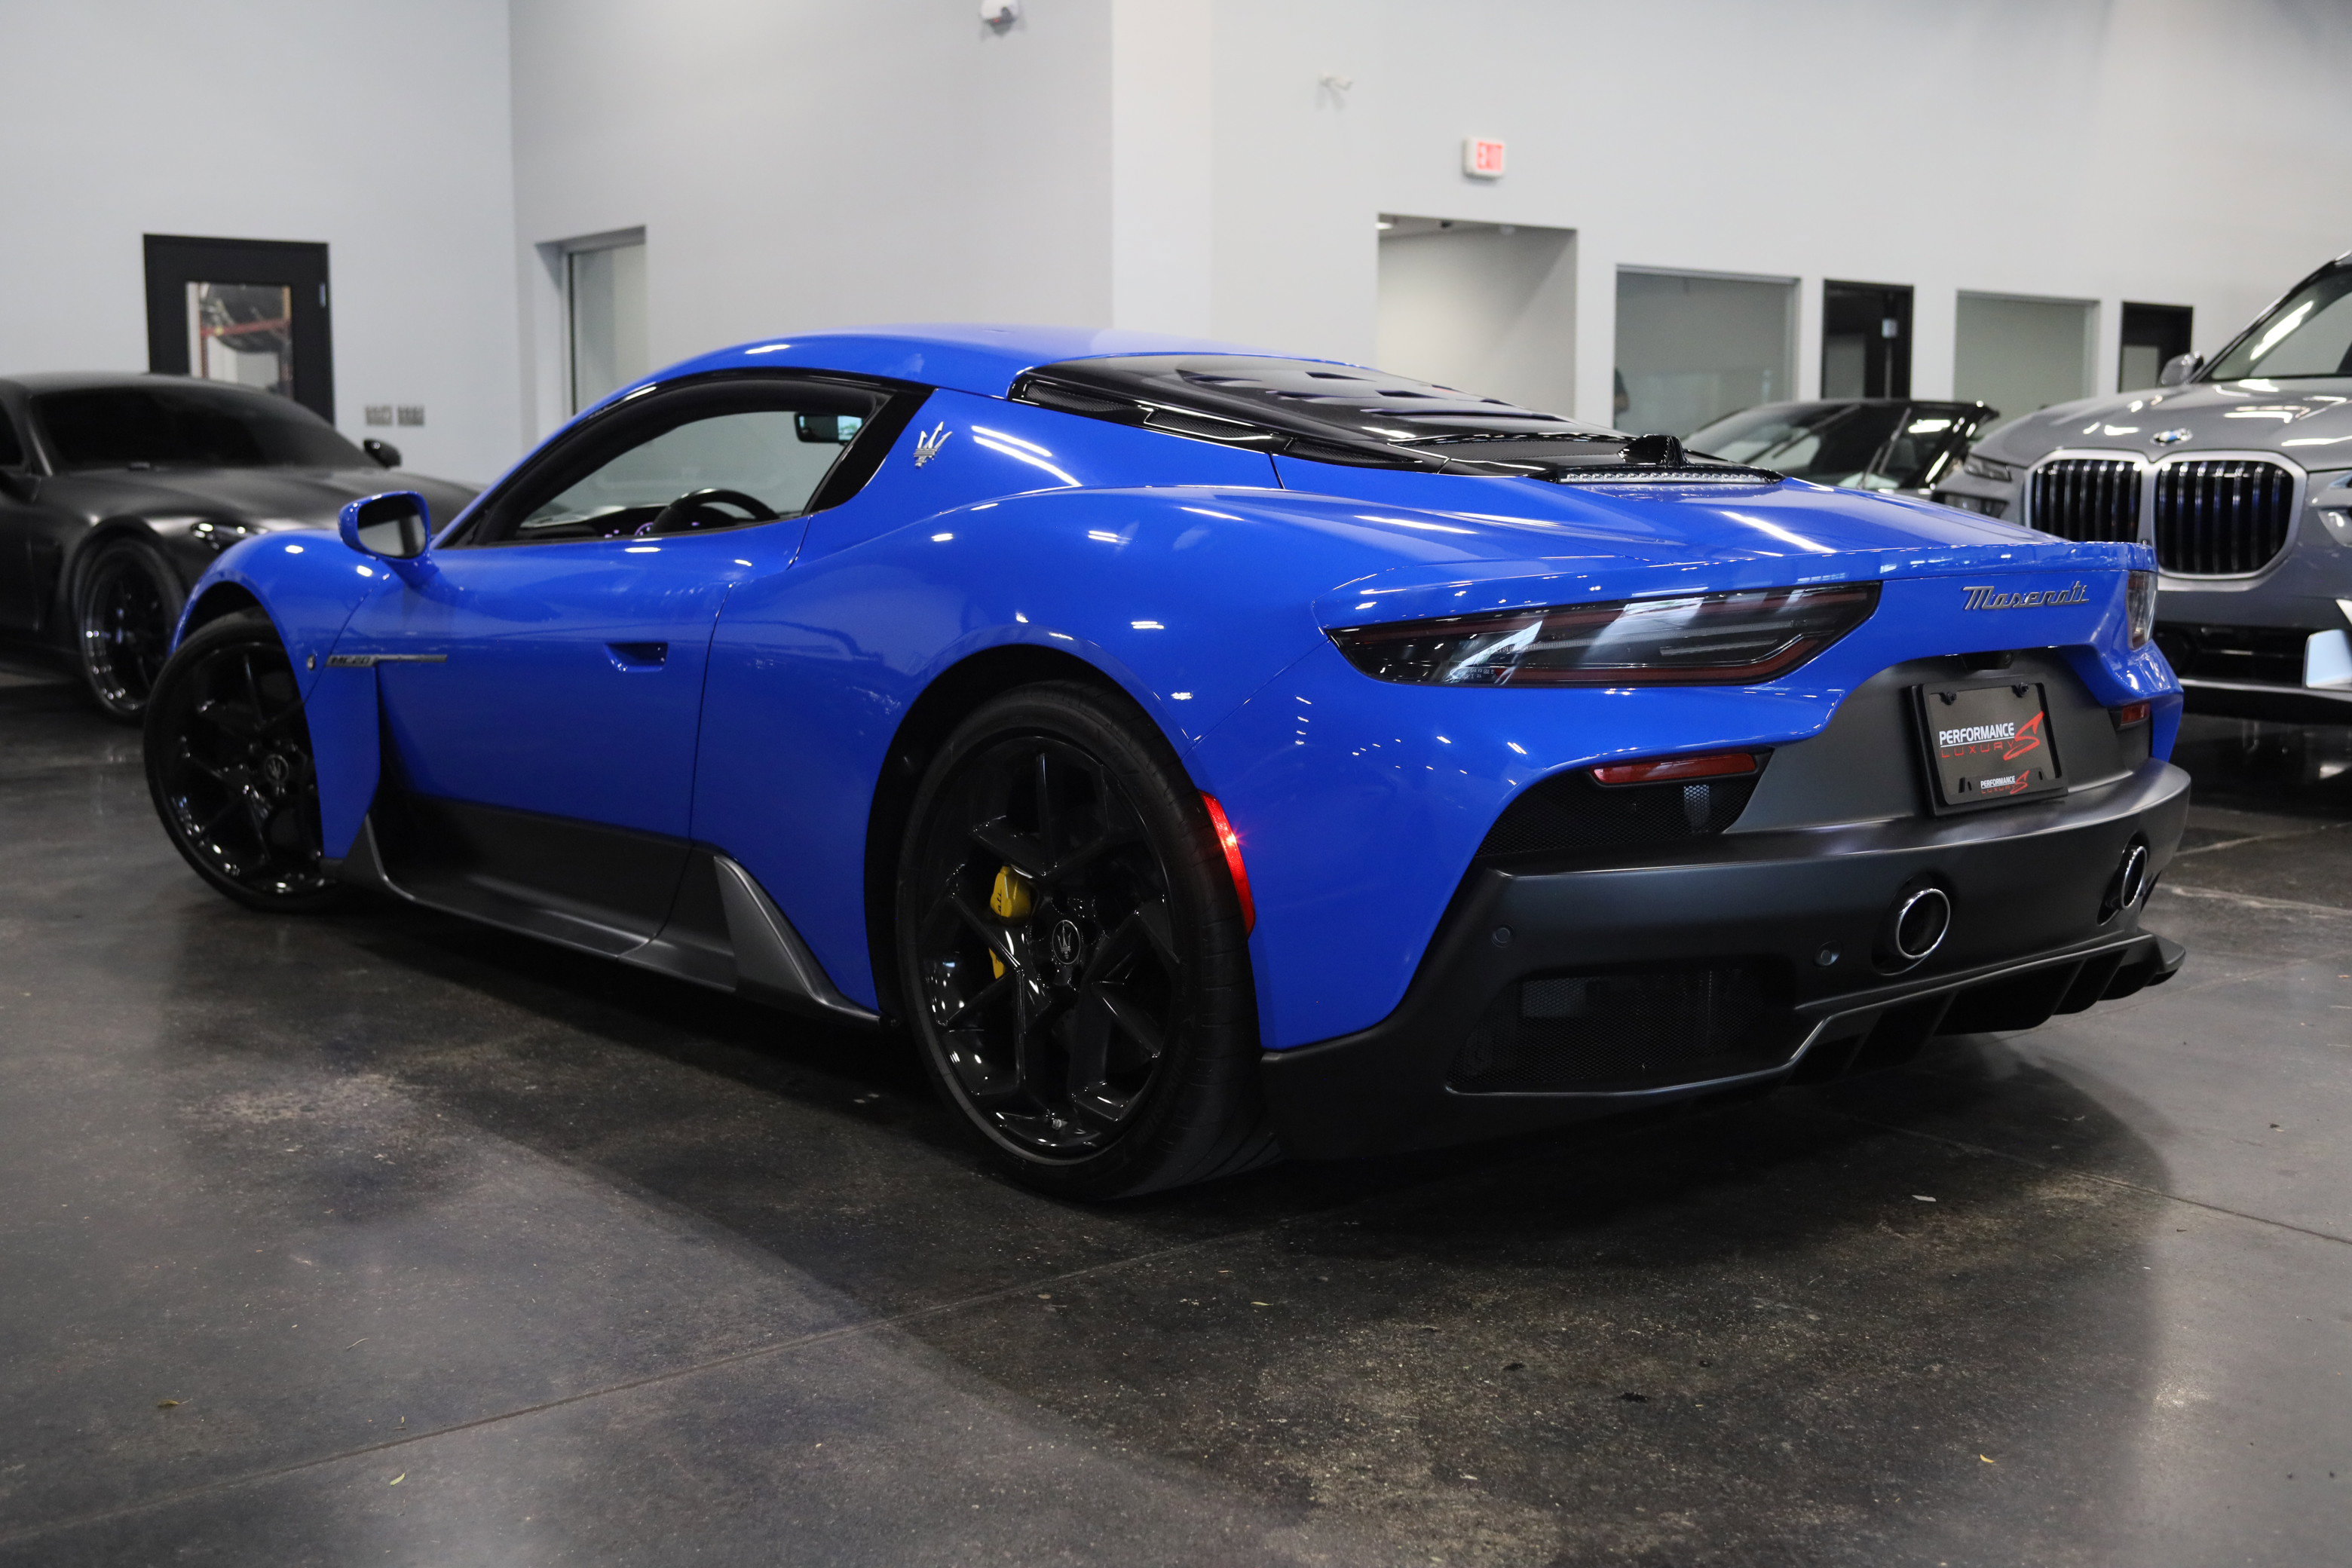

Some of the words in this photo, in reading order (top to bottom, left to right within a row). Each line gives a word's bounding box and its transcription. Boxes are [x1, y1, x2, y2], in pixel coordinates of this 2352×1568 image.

[1962, 580, 2090, 611] Maserati
[1939, 722, 2015, 746] PERFORMANCE
[1941, 740, 2015, 758] LUXURY
[1980, 776, 2016, 789] PERFORMANCE
